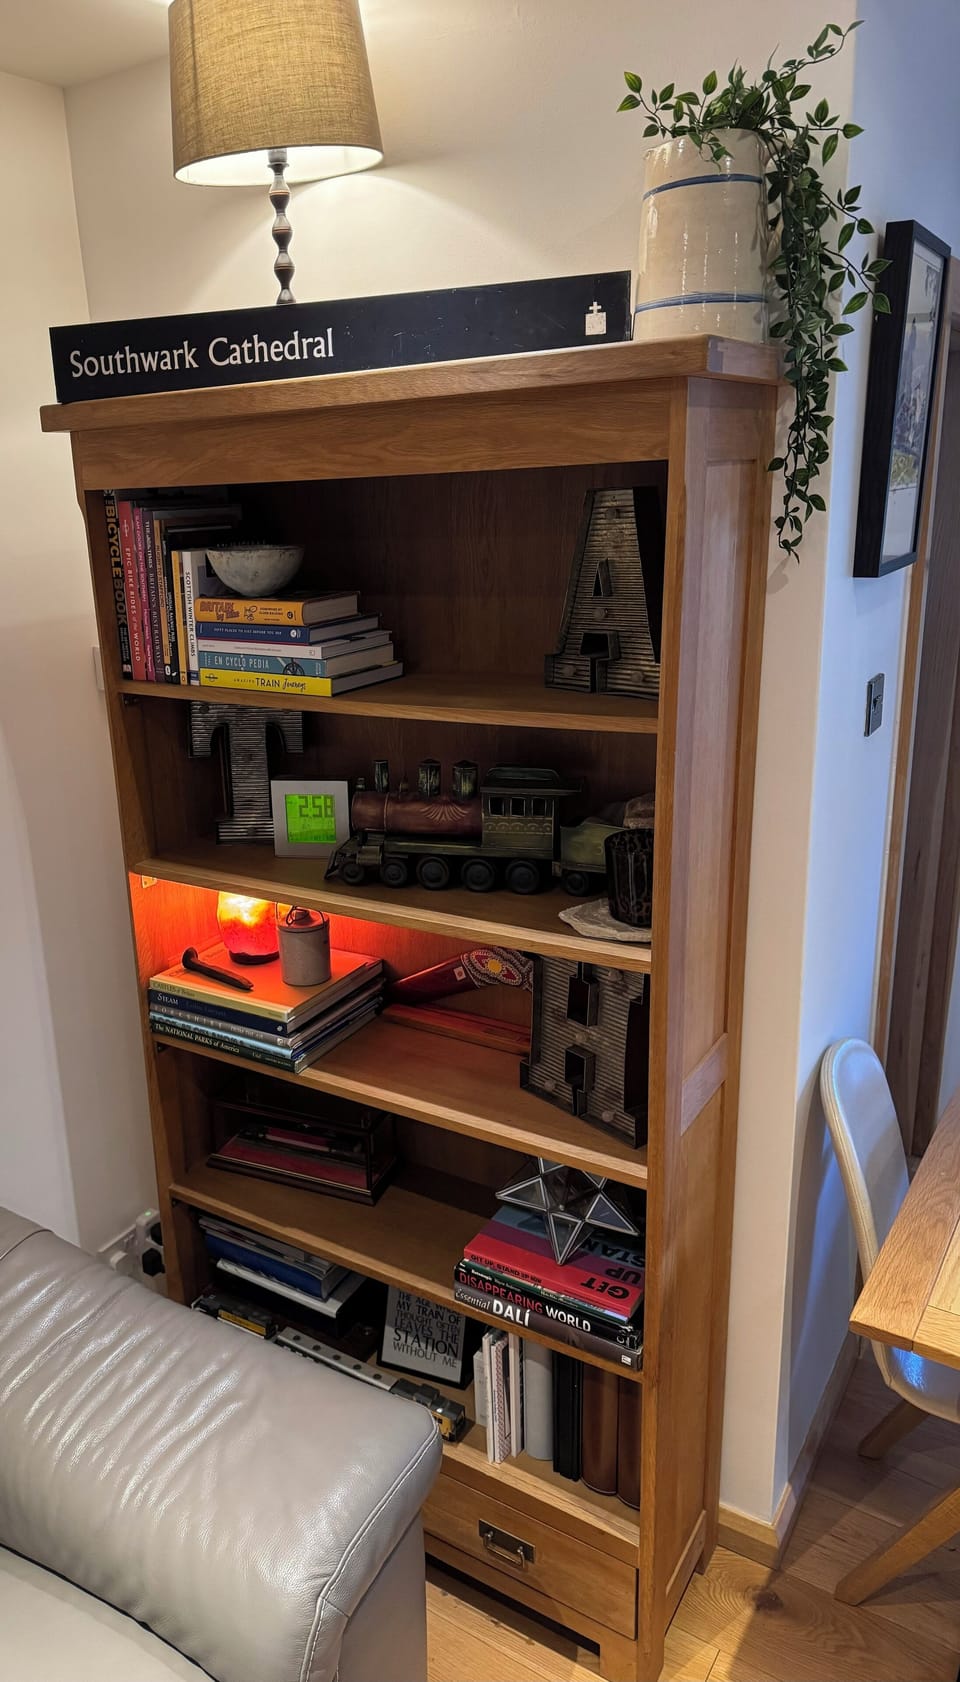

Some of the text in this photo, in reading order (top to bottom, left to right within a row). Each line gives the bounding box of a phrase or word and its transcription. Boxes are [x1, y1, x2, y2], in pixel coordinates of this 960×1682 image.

[70, 328, 334, 378] Southwark Cathedral
[105, 506, 122, 579] BICYCLE
[124, 547, 132, 566] EPIC
[126, 569, 134, 587] BIKE
[112, 578, 127, 624] BOOK
[129, 590, 137, 614] RIDES
[199, 601, 233, 613] BRITAIN
[148, 572, 157, 606] BRITAIN'S
[153, 625, 162, 664] RAILWAYS
[216, 611, 223, 621] by
[132, 632, 141, 661] WORLD
[214, 656, 223, 665] EN
[226, 655, 246, 667] CYCLO
[249, 658, 269, 669] PEDIA
[256, 678, 280, 687] TRAIN
[282, 678, 305, 692] Journeys
[298, 796, 333, 817] 2:58
[157, 992, 178, 1004] STEAM
[155, 1022, 164, 1032] The
[165, 1025, 193, 1040] NATIONAL
[194, 1033, 212, 1045] PARKS
[220, 1041, 239, 1053] America
[582, 1238, 645, 1268] STAN
[471, 1254, 482, 1262] GET
[496, 1263, 521, 1278] STAND
[529, 1274, 542, 1283] NOW
[605, 1267, 642, 1284] UP
[581, 1277, 630, 1299] GET
[396, 1301, 411, 1310] MY
[417, 1305, 444, 1320] TRAIN
[449, 1314, 461, 1325] OF
[455, 1288, 492, 1310] Essential
[493, 1300, 531, 1327] DALÍ
[459, 1272, 544, 1313] DISAPPEARING
[545, 1306, 592, 1333] WORLD
[395, 1318, 458, 1344] LEAVES THE
[397, 1310, 459, 1332] THOUGHT OFTEN
[393, 1327, 458, 1358] STATION
[393, 1342, 457, 1368] WITHOUT ME
